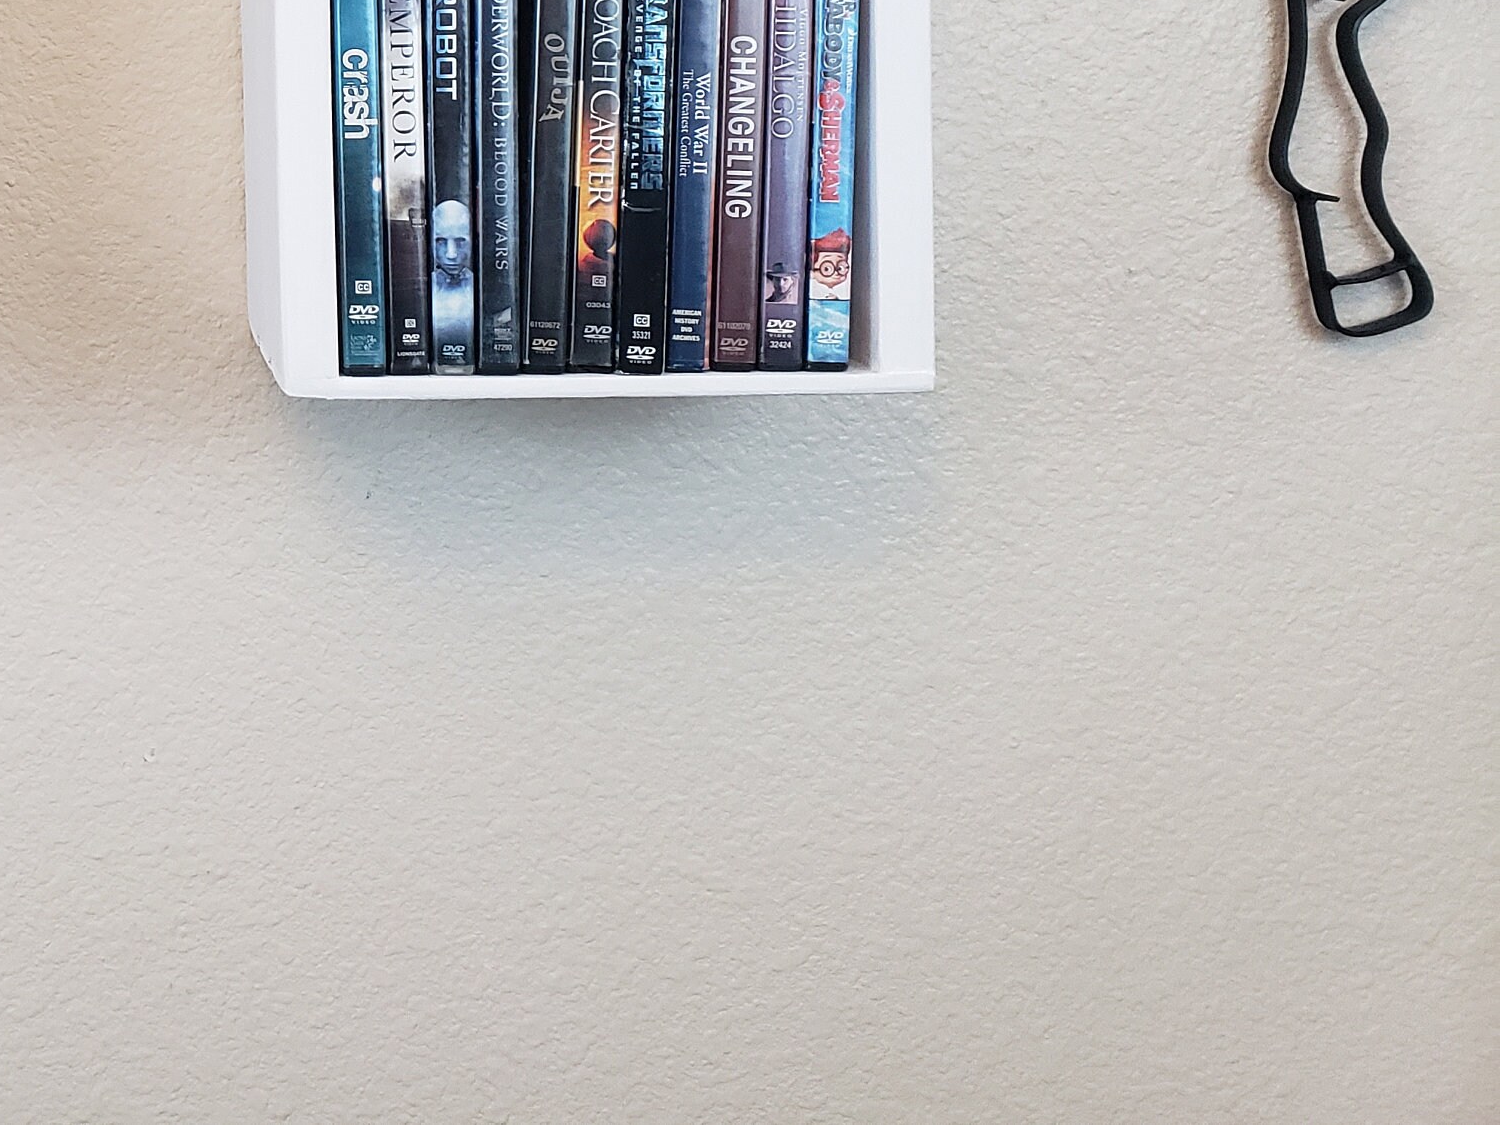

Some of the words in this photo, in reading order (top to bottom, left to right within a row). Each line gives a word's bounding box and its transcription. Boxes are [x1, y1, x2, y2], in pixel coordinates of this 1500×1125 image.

[539, 33, 572, 123] OUIJA
[683, 69, 695, 90] The
[342, 48, 378, 140] crash
[694, 72, 712, 120] World
[631, 97, 641, 123] THE
[681, 91, 694, 141] Greatest
[693, 123, 709, 157] War
[725, 35, 758, 219] CHANGELING
[588, 89, 621, 208] CARTER
[630, 132, 640, 190] FALLEN
[678, 142, 691, 178] Conflict
[819, 91, 845, 203] SHERMAN
[494, 138, 508, 207] BLOOD
[692, 158, 708, 175] II
[494, 218, 509, 271] WARS
[348, 304, 380, 315] DVD
[672, 309, 702, 317] AMERICAN
[766, 320, 797, 329] DVD
[531, 339, 559, 347] DVD
[584, 325, 613, 334] DVD
[719, 338, 749, 347] DVD
[817, 330, 844, 339] DVD
[442, 344, 466, 353] DVD
[626, 346, 656, 355] DVD
